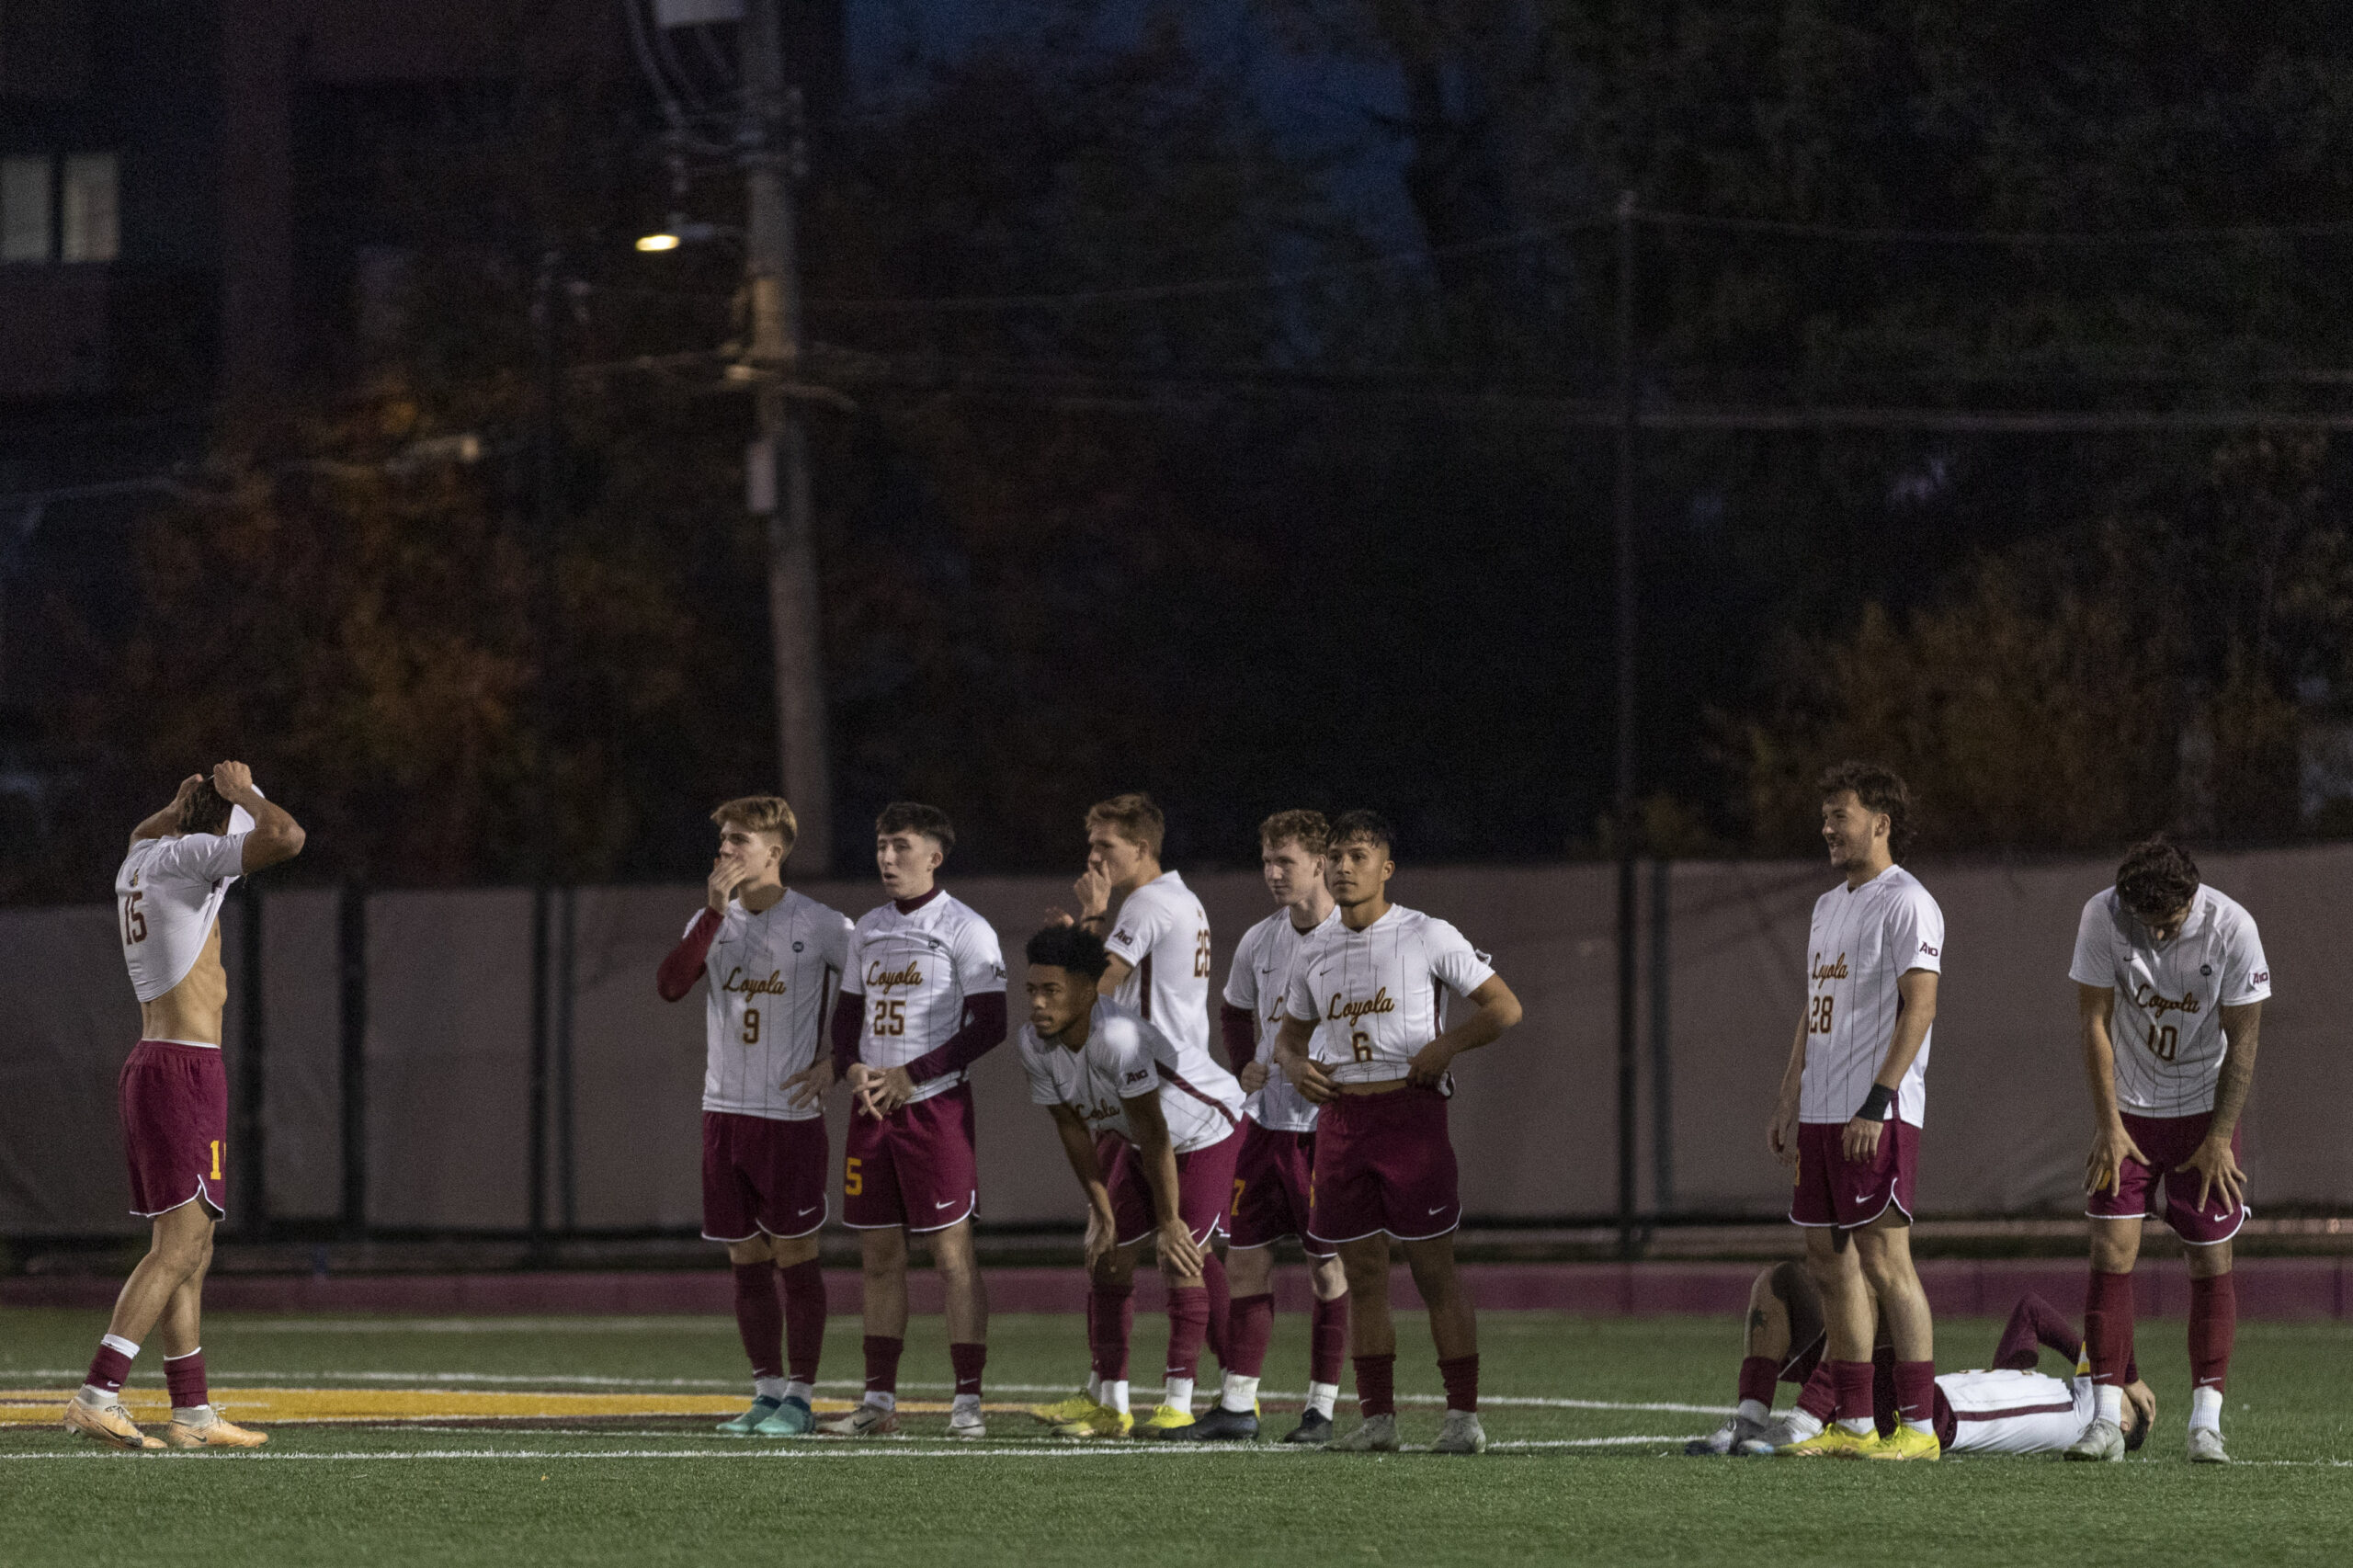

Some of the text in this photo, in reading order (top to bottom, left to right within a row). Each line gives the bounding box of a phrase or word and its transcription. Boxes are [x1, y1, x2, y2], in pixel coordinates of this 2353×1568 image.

[124, 891, 147, 946] 15
[722, 966, 787, 1004] Loyola
[866, 960, 924, 994] Loyola
[874, 1000, 906, 1036] 25
[1326, 986, 1395, 1028] Loyola
[1809, 995, 1835, 1034] 28
[2135, 983, 2200, 1018] Loyola
[743, 1008, 760, 1044] 9
[2148, 1023, 2178, 1062] 10
[1352, 1031, 1374, 1062] 6
